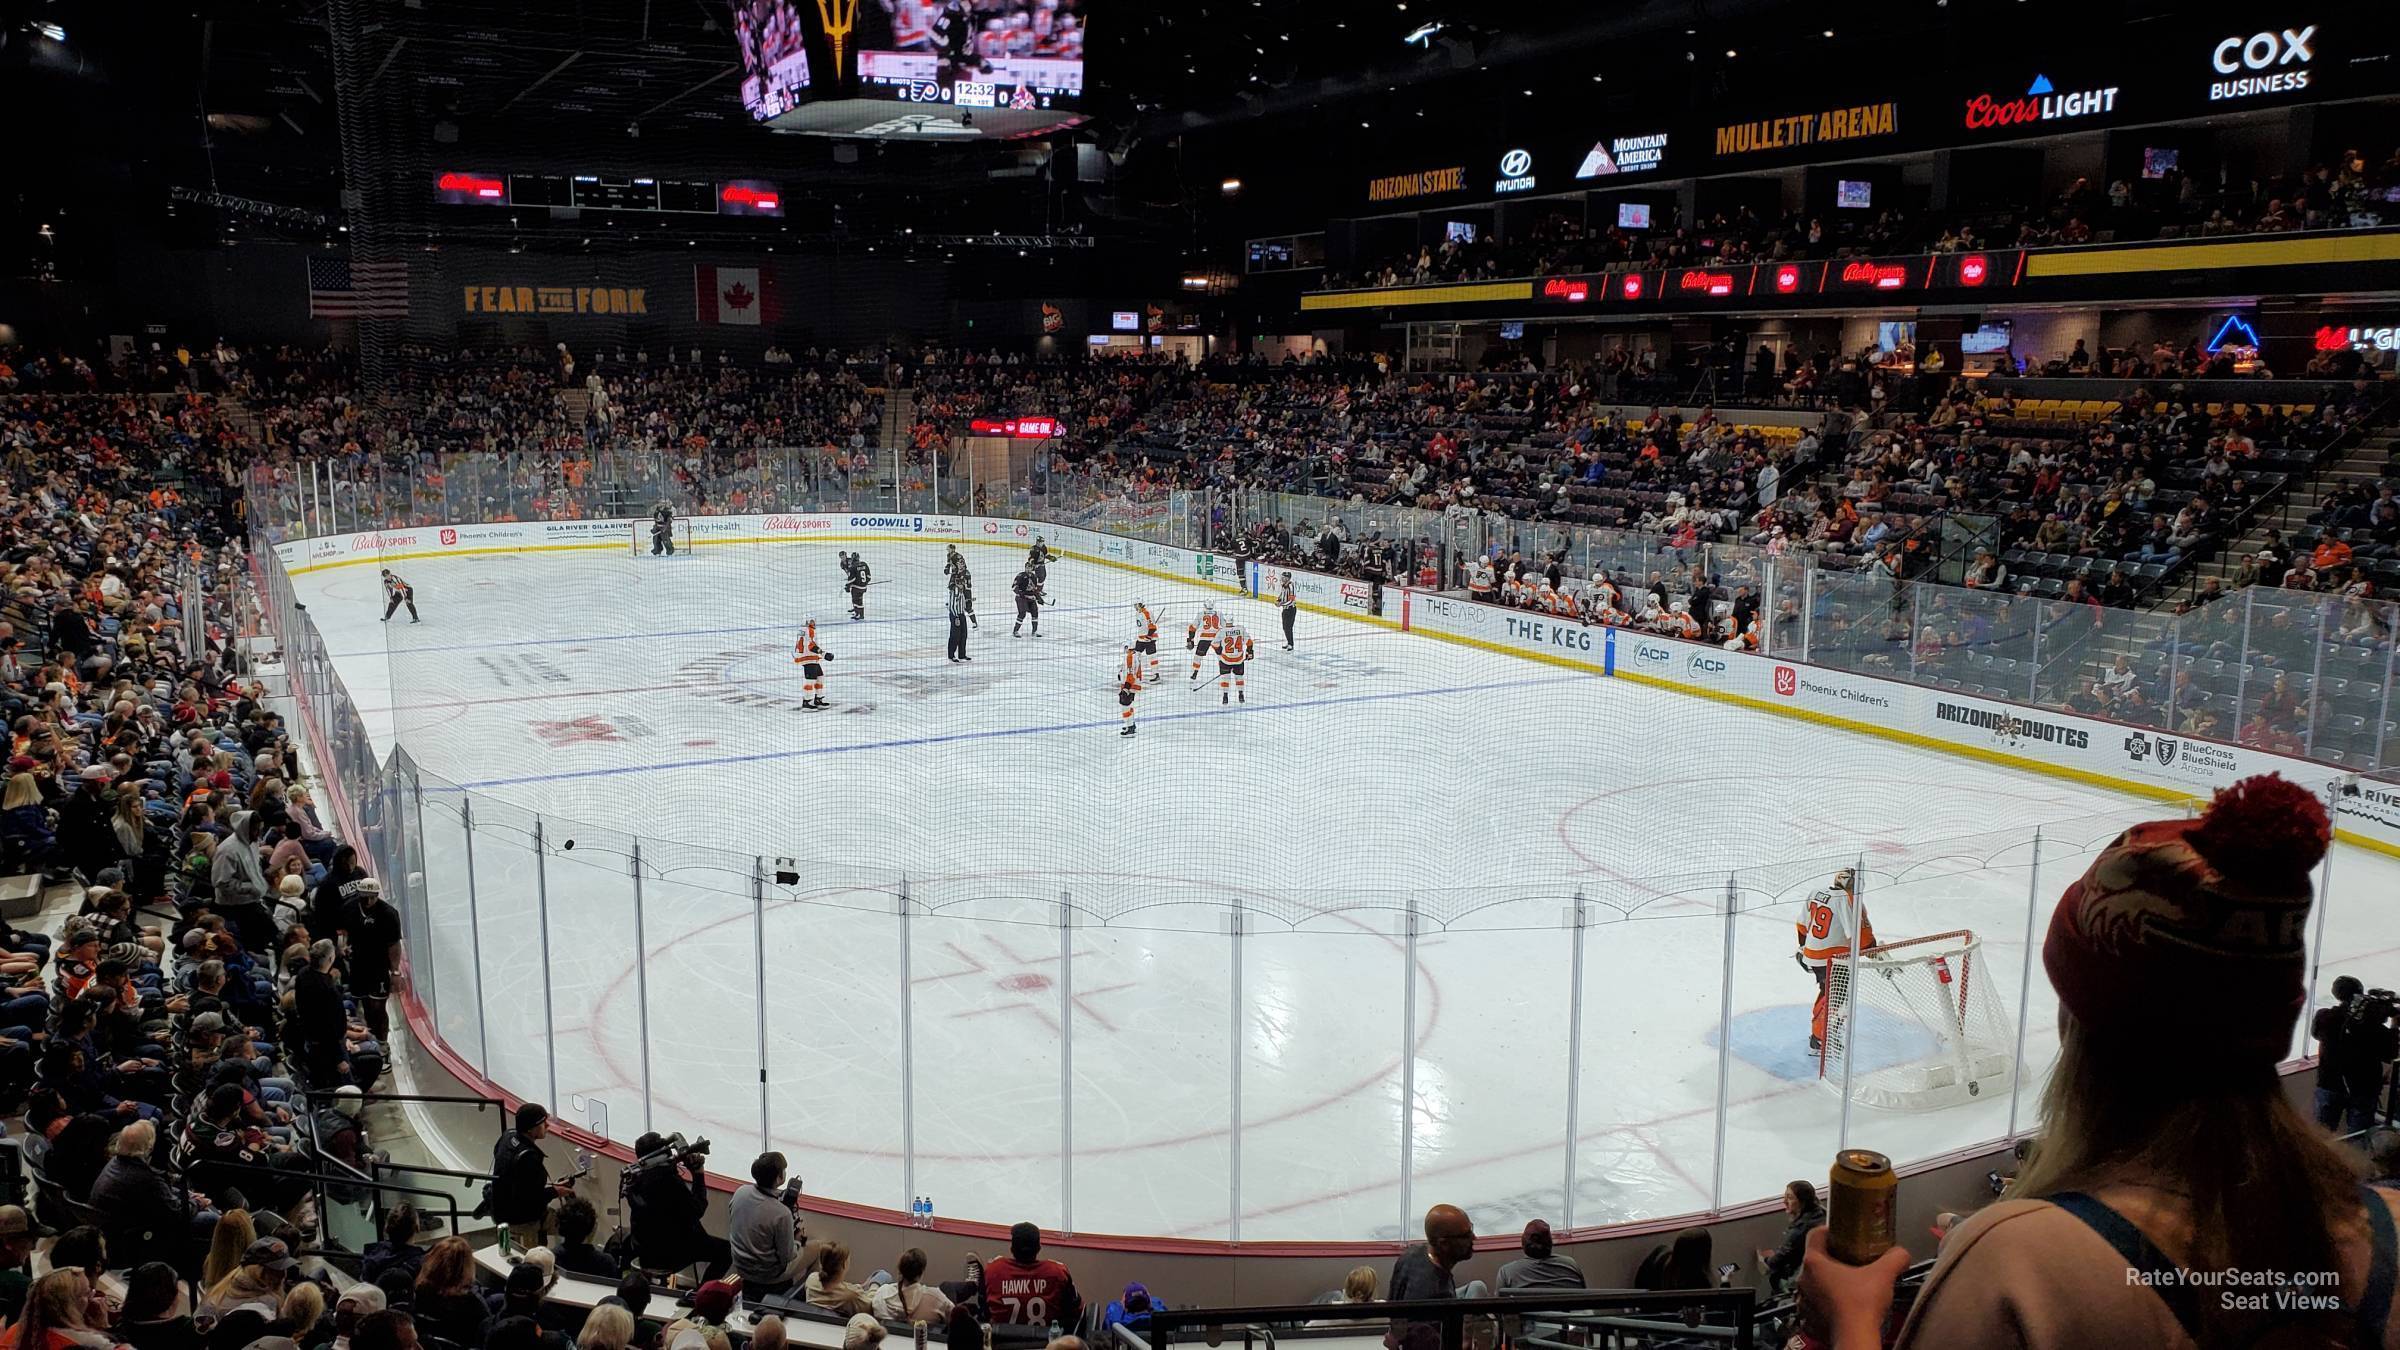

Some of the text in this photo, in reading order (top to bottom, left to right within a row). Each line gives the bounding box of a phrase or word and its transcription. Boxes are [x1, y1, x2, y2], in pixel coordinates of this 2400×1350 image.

[2212, 25, 2316, 74] COX
[898, 88, 906, 98] 6
[957, 82, 995, 96] 12:32
[2210, 70, 2310, 100] BUSINESS
[942, 88, 951, 100] 0
[999, 91, 1007, 104] 0
[1042, 97, 1050, 107] 2
[1965, 88, 2118, 129] Coors LIGHT
[1715, 102, 1895, 155] MULLETT ARENA
[1613, 133, 1667, 153] MOUNTAIN
[1616, 148, 1662, 166] AMERICA
[1368, 167, 1462, 201] ARIZONA STATE
[1495, 176, 1536, 193] HYUNDAI
[1681, 272, 1710, 289] Bally
[1843, 263, 1877, 284] Bally
[464, 286, 647, 314] FEAR THE FORK
[1019, 422, 1039, 434] GAME
[678, 521, 740, 534] Dignity Health
[762, 516, 831, 532] Bally SPORTS
[850, 517, 910, 528] GOODWILL
[352, 534, 416, 552] Bally SPORTS
[489, 531, 523, 539] Children's
[1238, 540, 1247, 551] 2
[860, 570, 867, 583] 9
[1303, 581, 1323, 594] Health
[1343, 584, 1368, 597] ARIZO
[1346, 597, 1368, 609] SPOR
[1506, 617, 1543, 641] THE
[1552, 626, 1591, 651] KEG
[1224, 636, 1243, 653] 24
[1639, 647, 1669, 661] ACP
[1694, 660, 1725, 673] ACP
[1800, 680, 1889, 708] Phoenix Children's
[2012, 717, 2089, 749] COYOTES
[2183, 741, 2234, 760] BlueCross
[2181, 762, 2213, 777] Arizona
[2182, 752, 2237, 771] BlueShield
[2365, 790, 2400, 808] RIVE
[338, 880, 361, 897] DIESE
[1002, 1279, 1047, 1294] HAWK VP
[1002, 1297, 1046, 1327] 78
